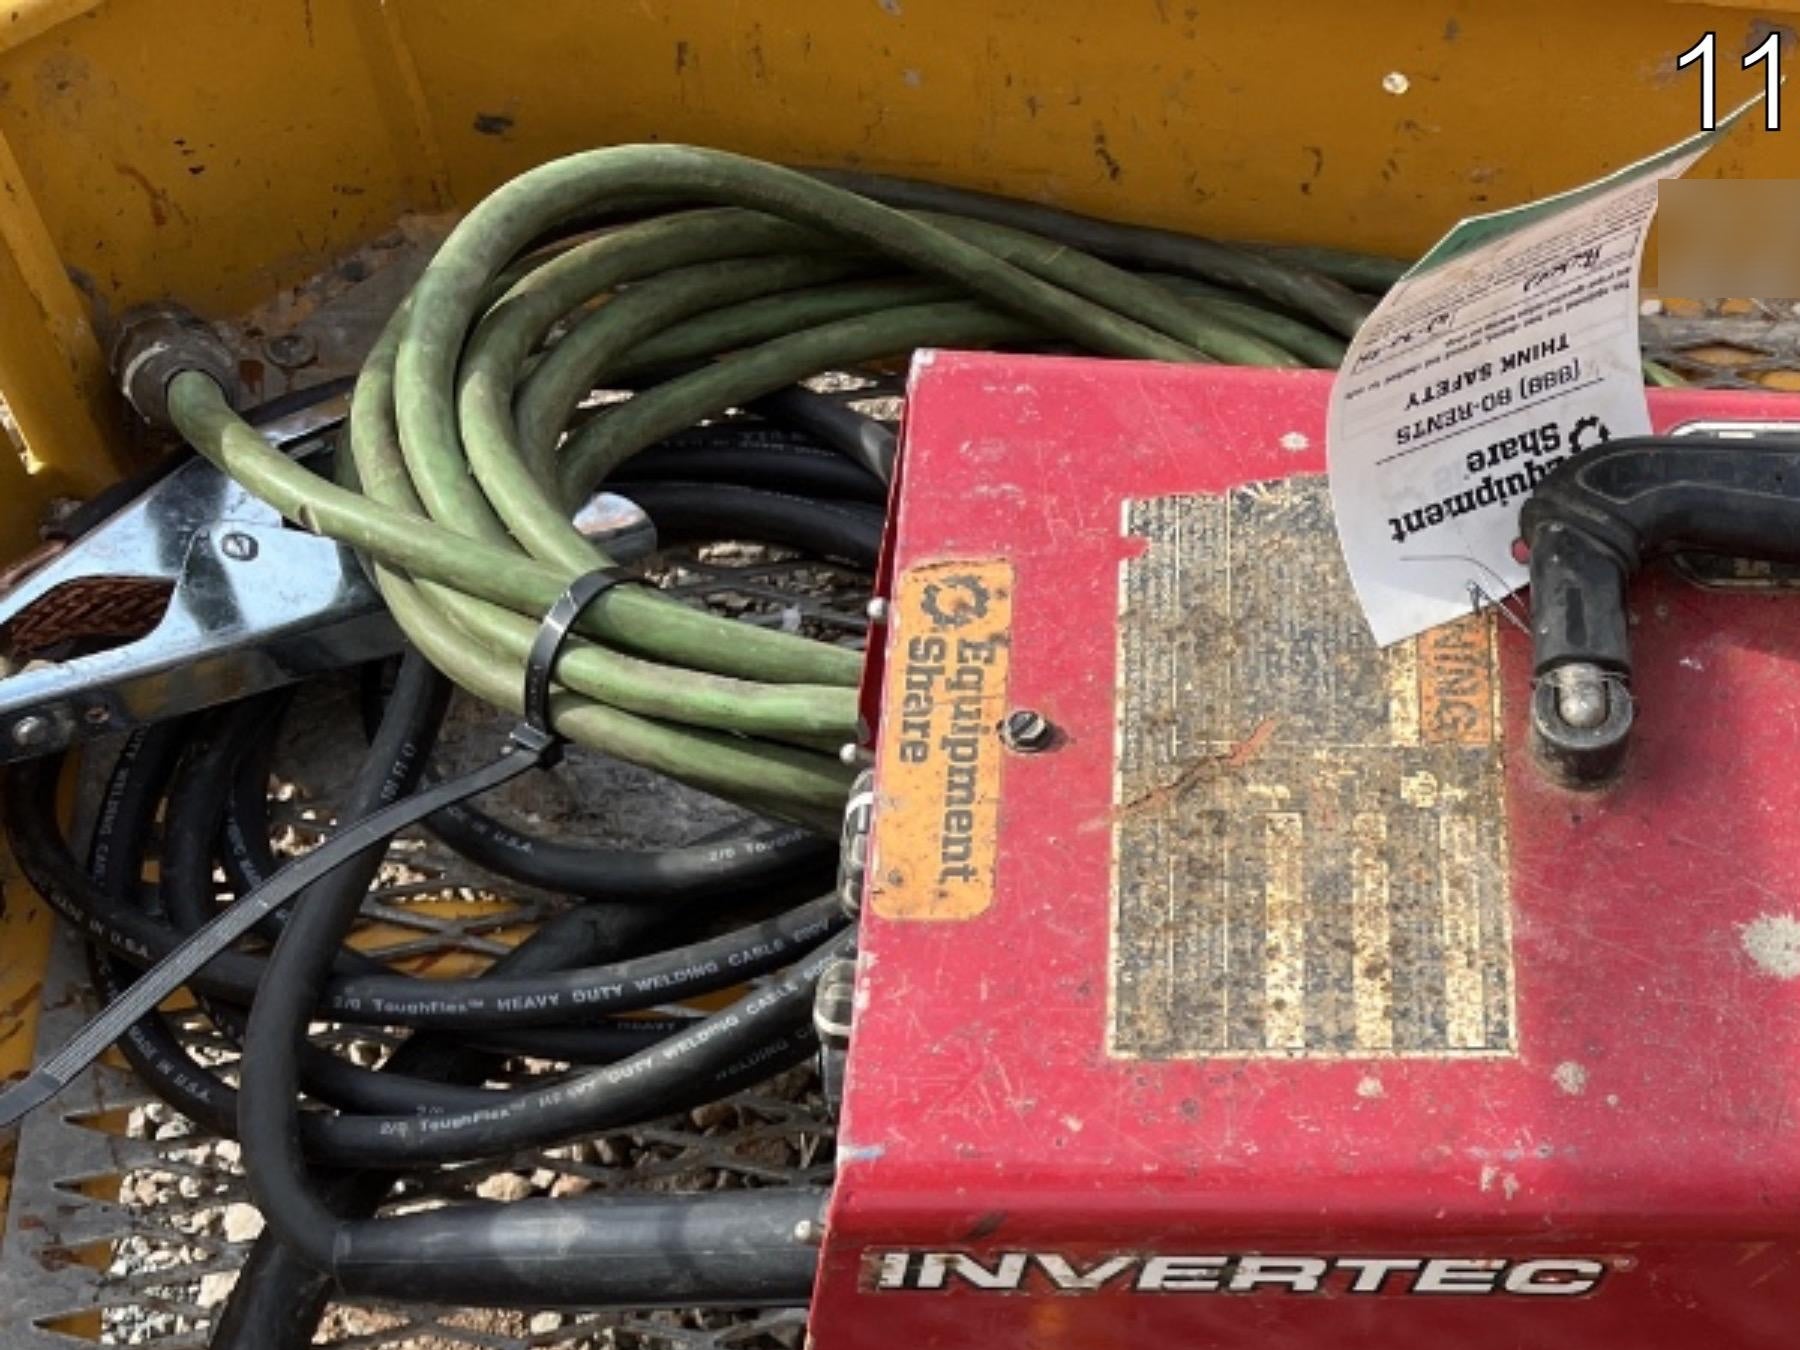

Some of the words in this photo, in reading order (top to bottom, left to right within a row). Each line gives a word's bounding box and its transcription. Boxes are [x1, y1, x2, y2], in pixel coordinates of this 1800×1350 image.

[1501, 335, 1571, 374] THINK
[1405, 363, 1494, 411] SAFETY
[1466, 422, 1561, 473] Share
[900, 635, 948, 765] Share
[938, 639, 995, 884] Equipment
[498, 993, 560, 1012] HEAVY
[573, 982, 624, 1004] DUTY
[636, 961, 719, 994] WELDING
[728, 939, 785, 969] CABLE
[607, 1055, 653, 1085] DUTY
[663, 1013, 739, 1060] WELDING
[878, 1253, 1606, 1295] INVERTEC
